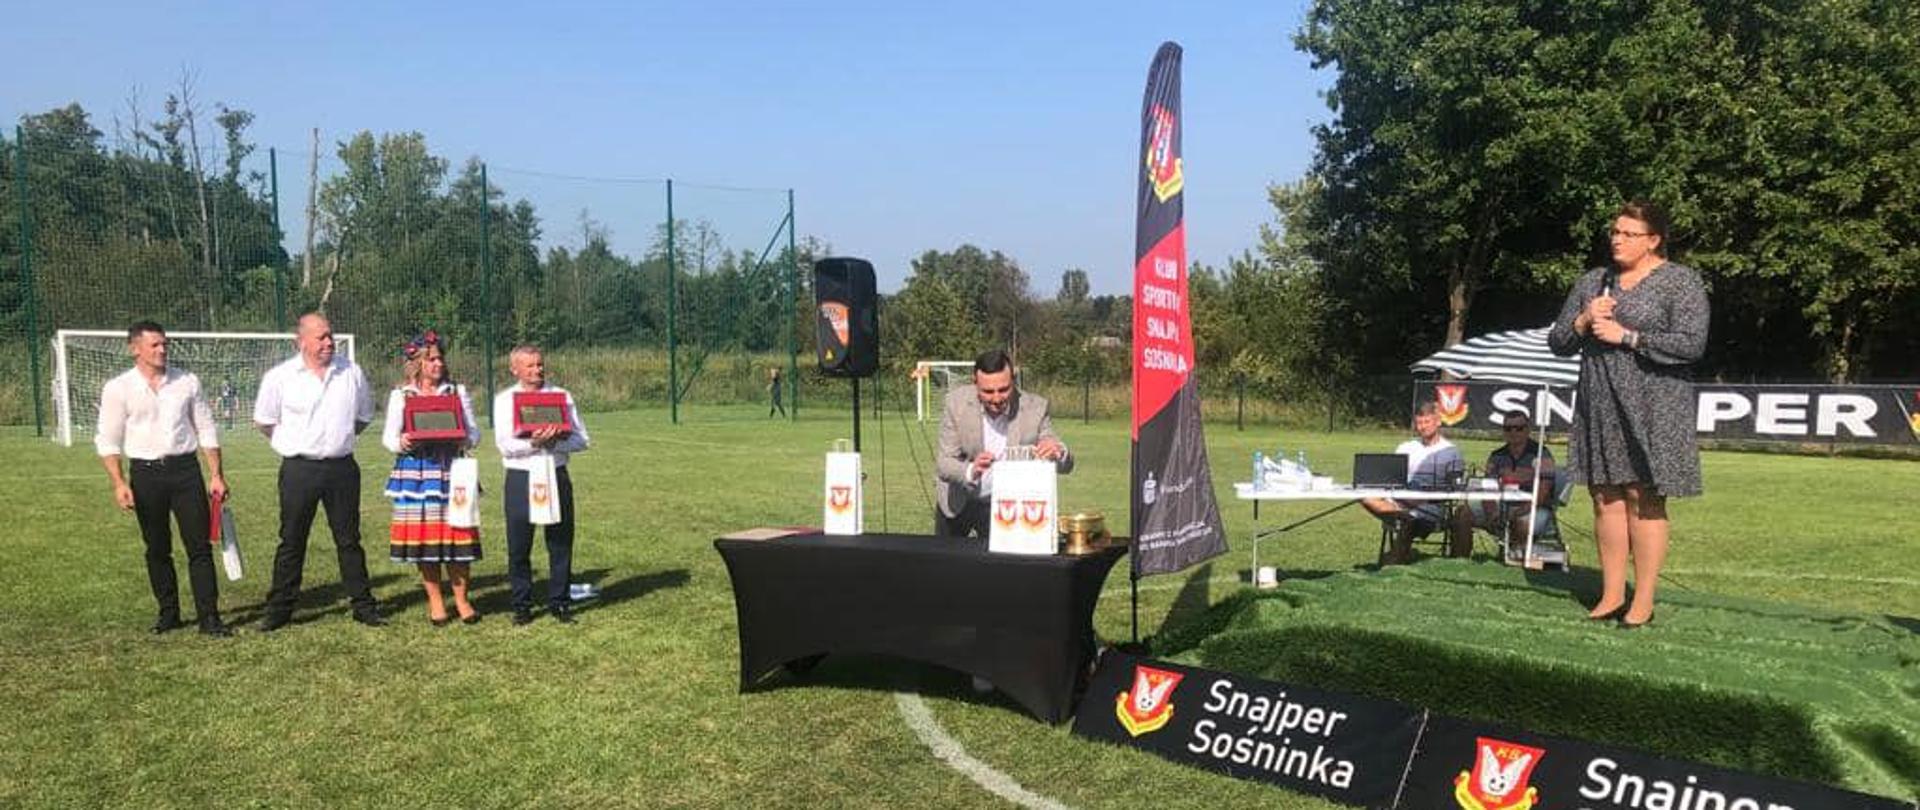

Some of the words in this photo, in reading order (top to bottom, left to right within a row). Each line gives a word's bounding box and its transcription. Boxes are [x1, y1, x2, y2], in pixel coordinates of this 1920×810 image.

[1488, 388, 1878, 437] SNPER
[1203, 679, 1347, 738] Snajper
[1188, 719, 1355, 789] Sośninka
